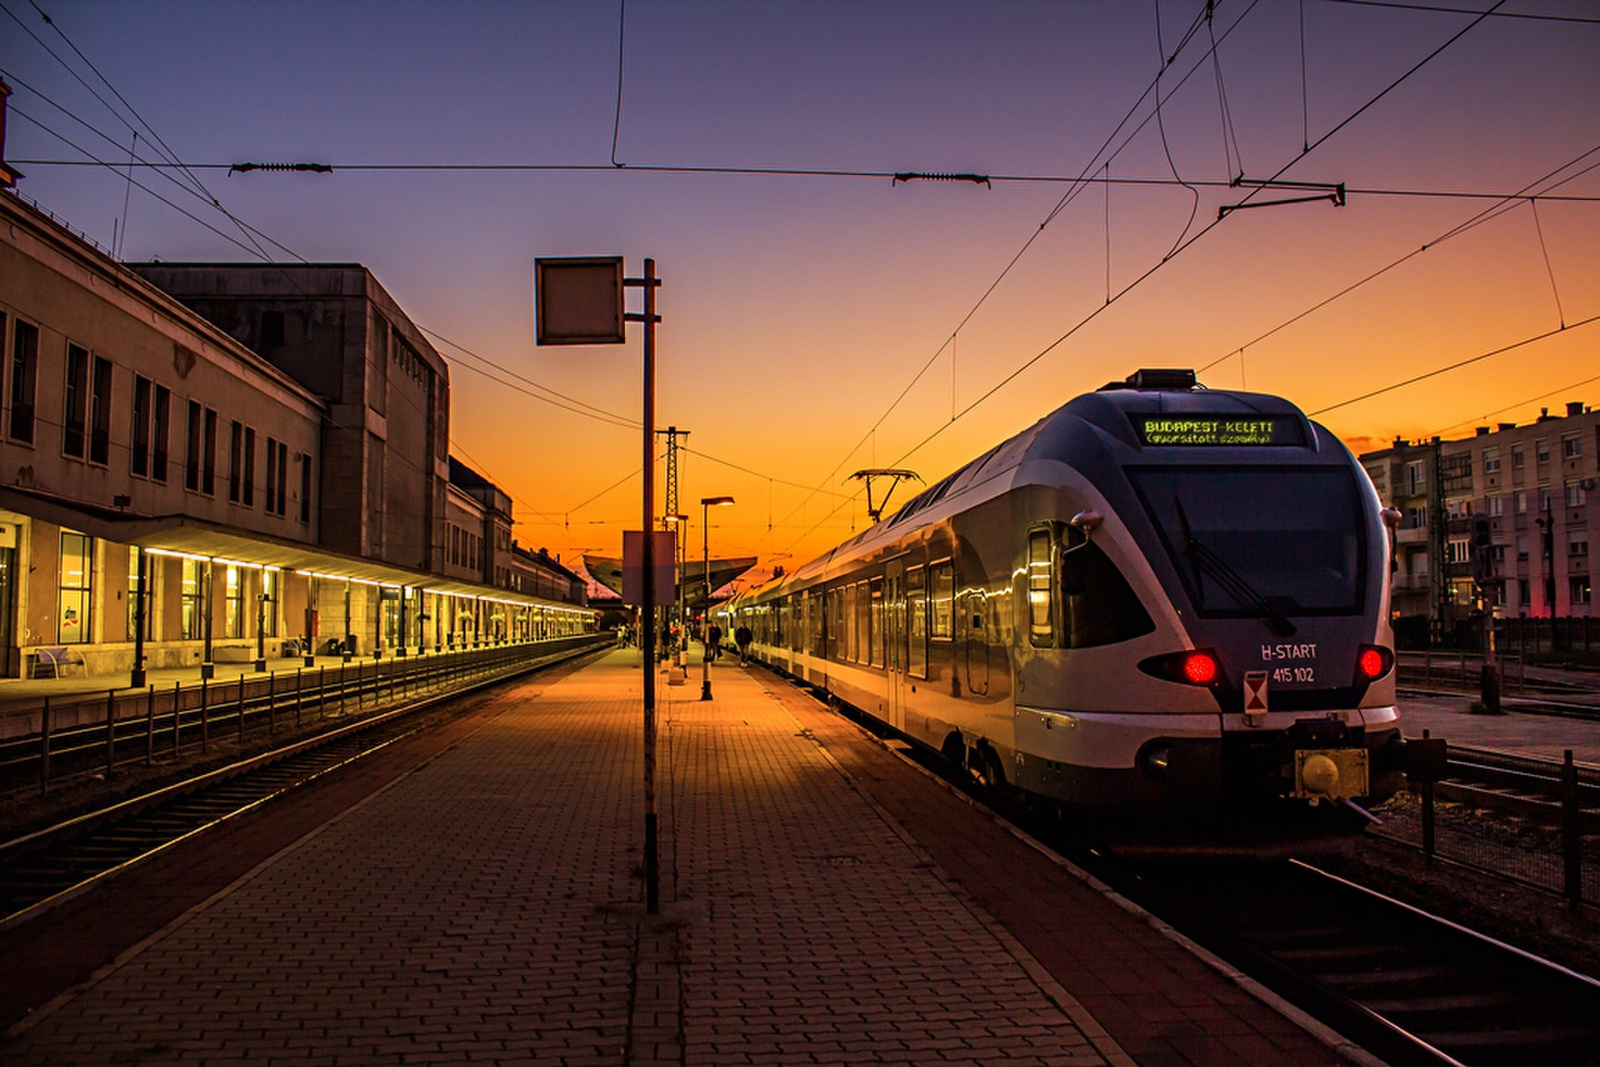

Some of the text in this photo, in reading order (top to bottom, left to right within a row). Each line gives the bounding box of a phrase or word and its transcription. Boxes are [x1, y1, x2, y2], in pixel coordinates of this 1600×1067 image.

[1144, 421, 1273, 433] BUDAPEST-KELETI
[1261, 643, 1317, 660] H-START
[1273, 667, 1315, 682] 415 102
